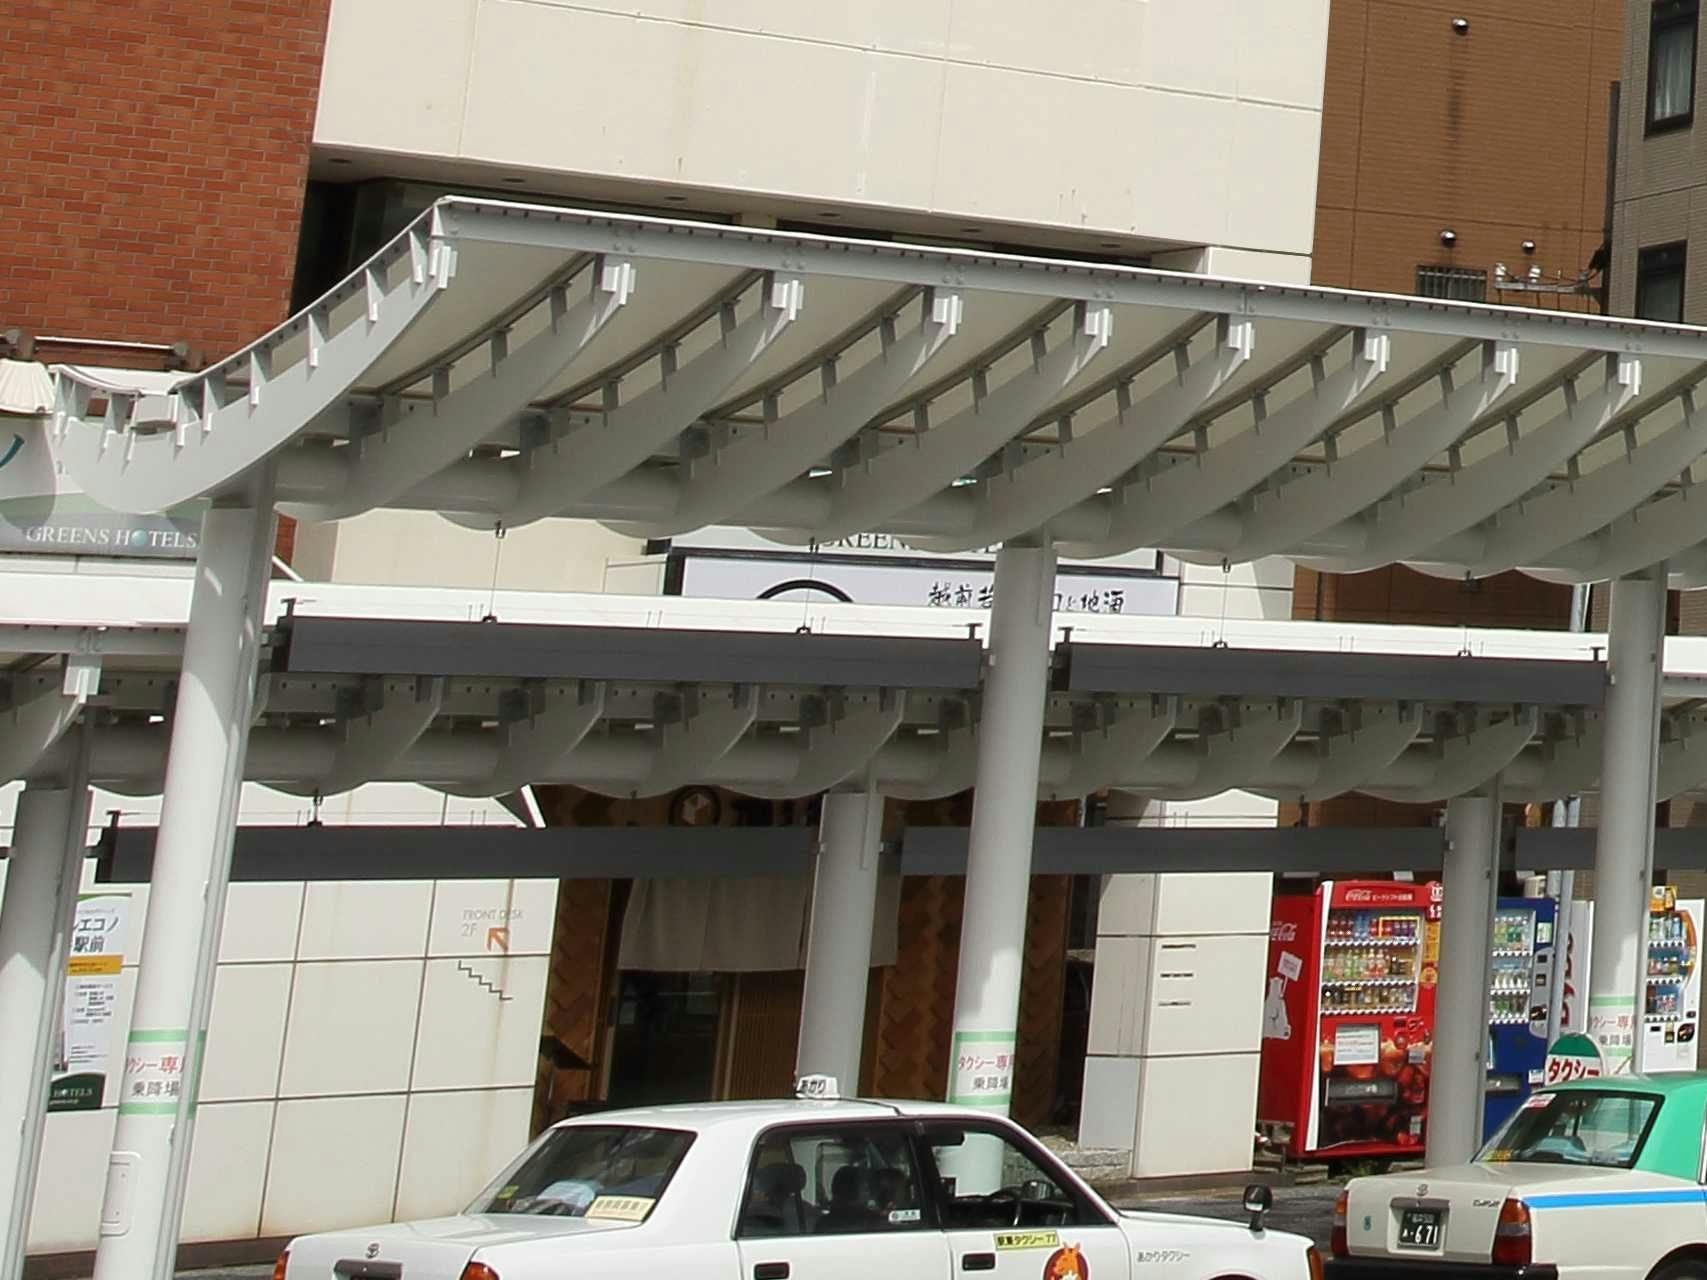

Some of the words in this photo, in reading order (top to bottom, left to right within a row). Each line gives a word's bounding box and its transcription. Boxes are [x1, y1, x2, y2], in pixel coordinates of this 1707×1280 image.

[26, 525, 109, 545] GREENS
[1547, 1057, 1600, 1082] タクシー
